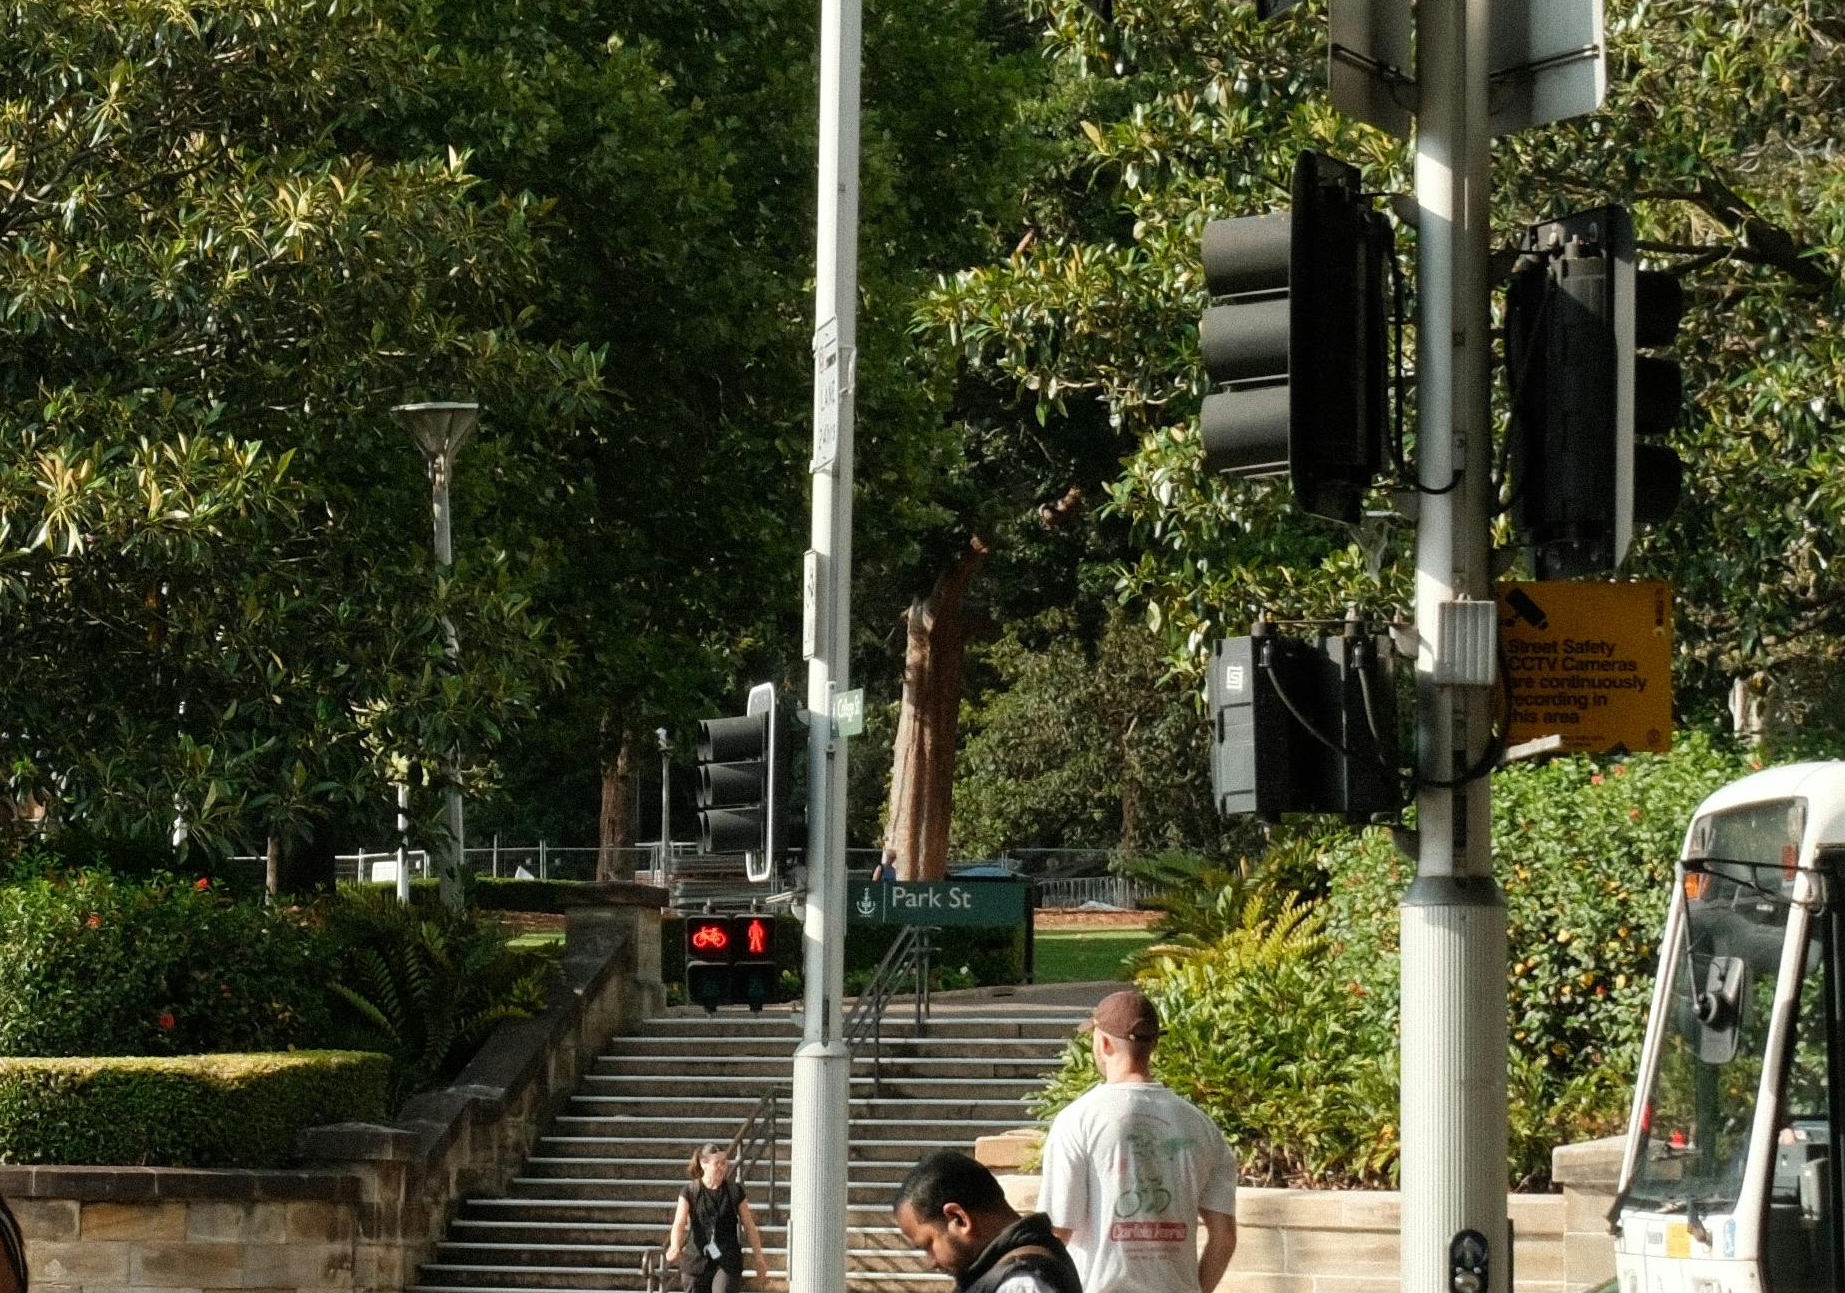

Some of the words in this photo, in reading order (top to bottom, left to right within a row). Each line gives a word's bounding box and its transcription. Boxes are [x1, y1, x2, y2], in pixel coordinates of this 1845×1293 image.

[1508, 639, 1559, 654] Street
[1563, 639, 1618, 658] Safety
[1509, 657, 1558, 672] CCTV
[1562, 657, 1638, 672] Cameras
[1540, 675, 1648, 693] continuously
[1592, 693, 1609, 706] in
[1542, 712, 1580, 724] area
[892, 886, 942, 908] Park
[949, 886, 971, 909] St
